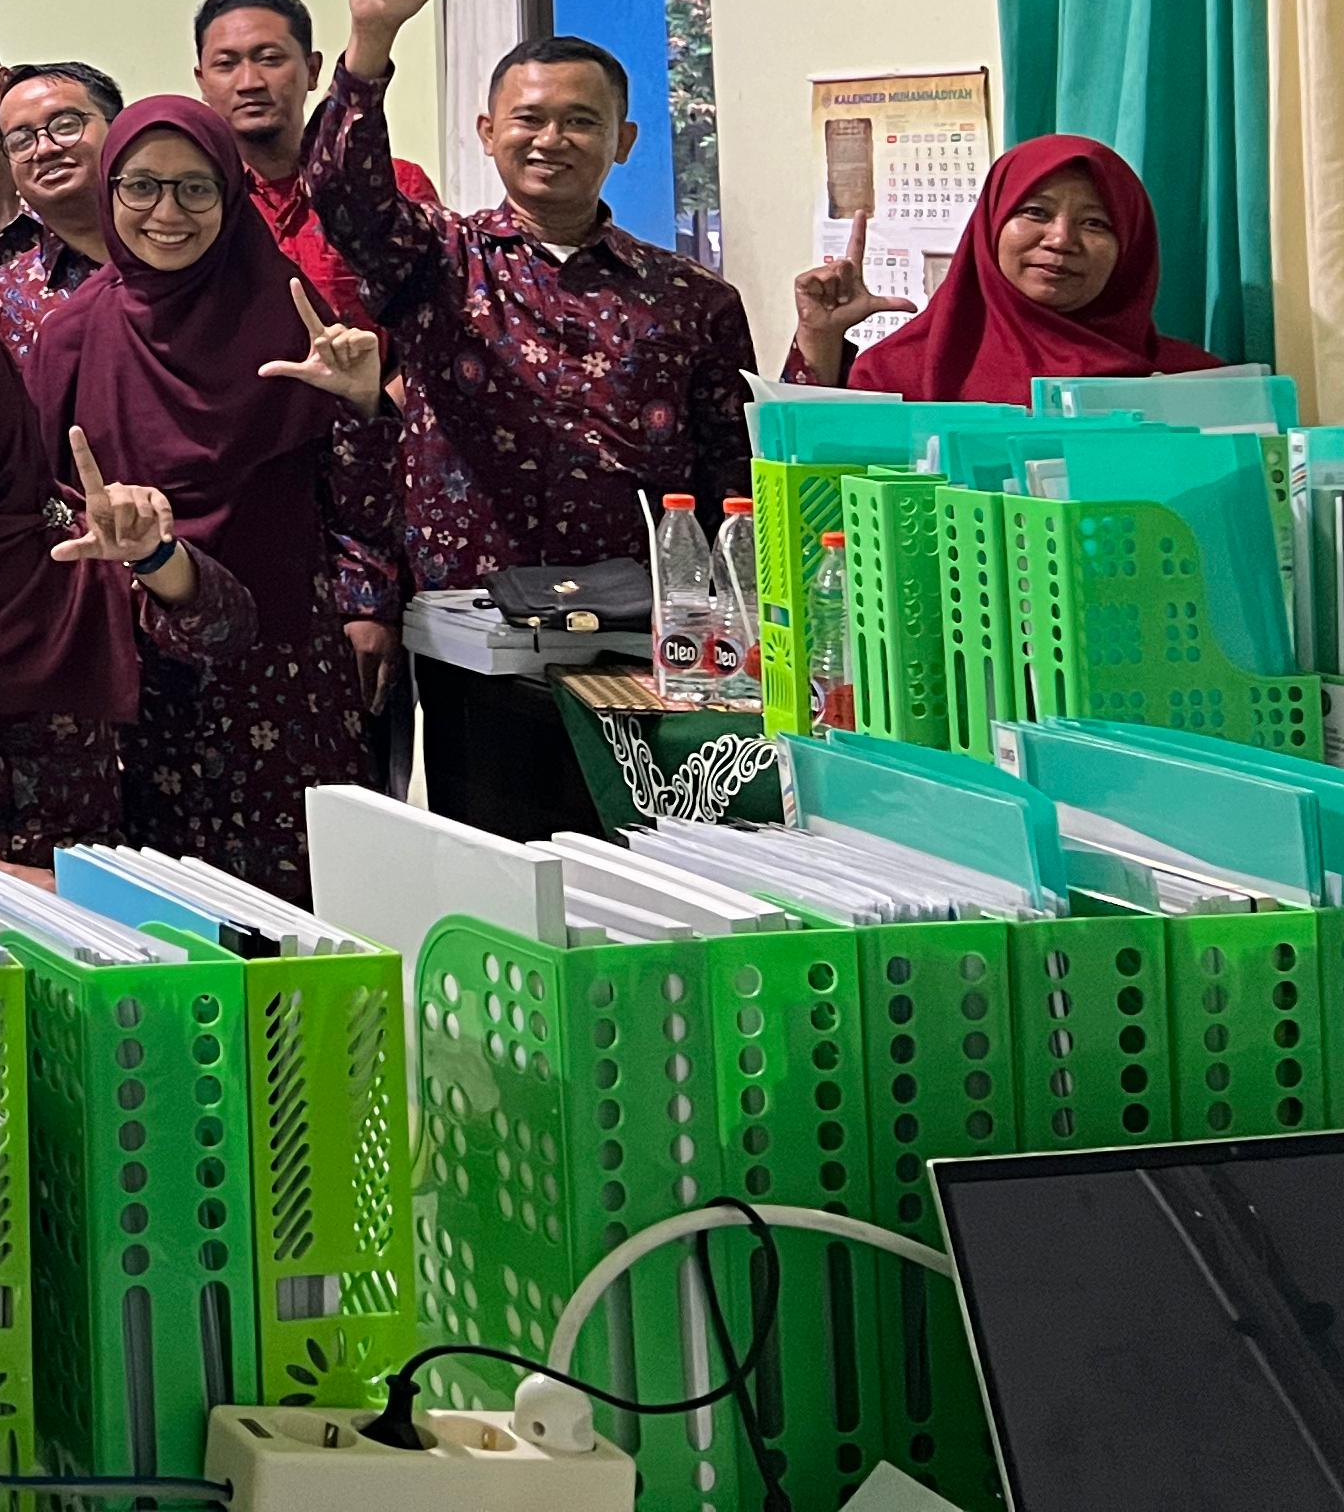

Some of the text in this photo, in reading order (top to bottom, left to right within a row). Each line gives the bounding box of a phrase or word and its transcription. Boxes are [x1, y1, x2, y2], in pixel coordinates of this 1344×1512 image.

[834, 89, 972, 105] KALENDER MUHAMMADIYAH
[665, 641, 696, 662] Cleo
